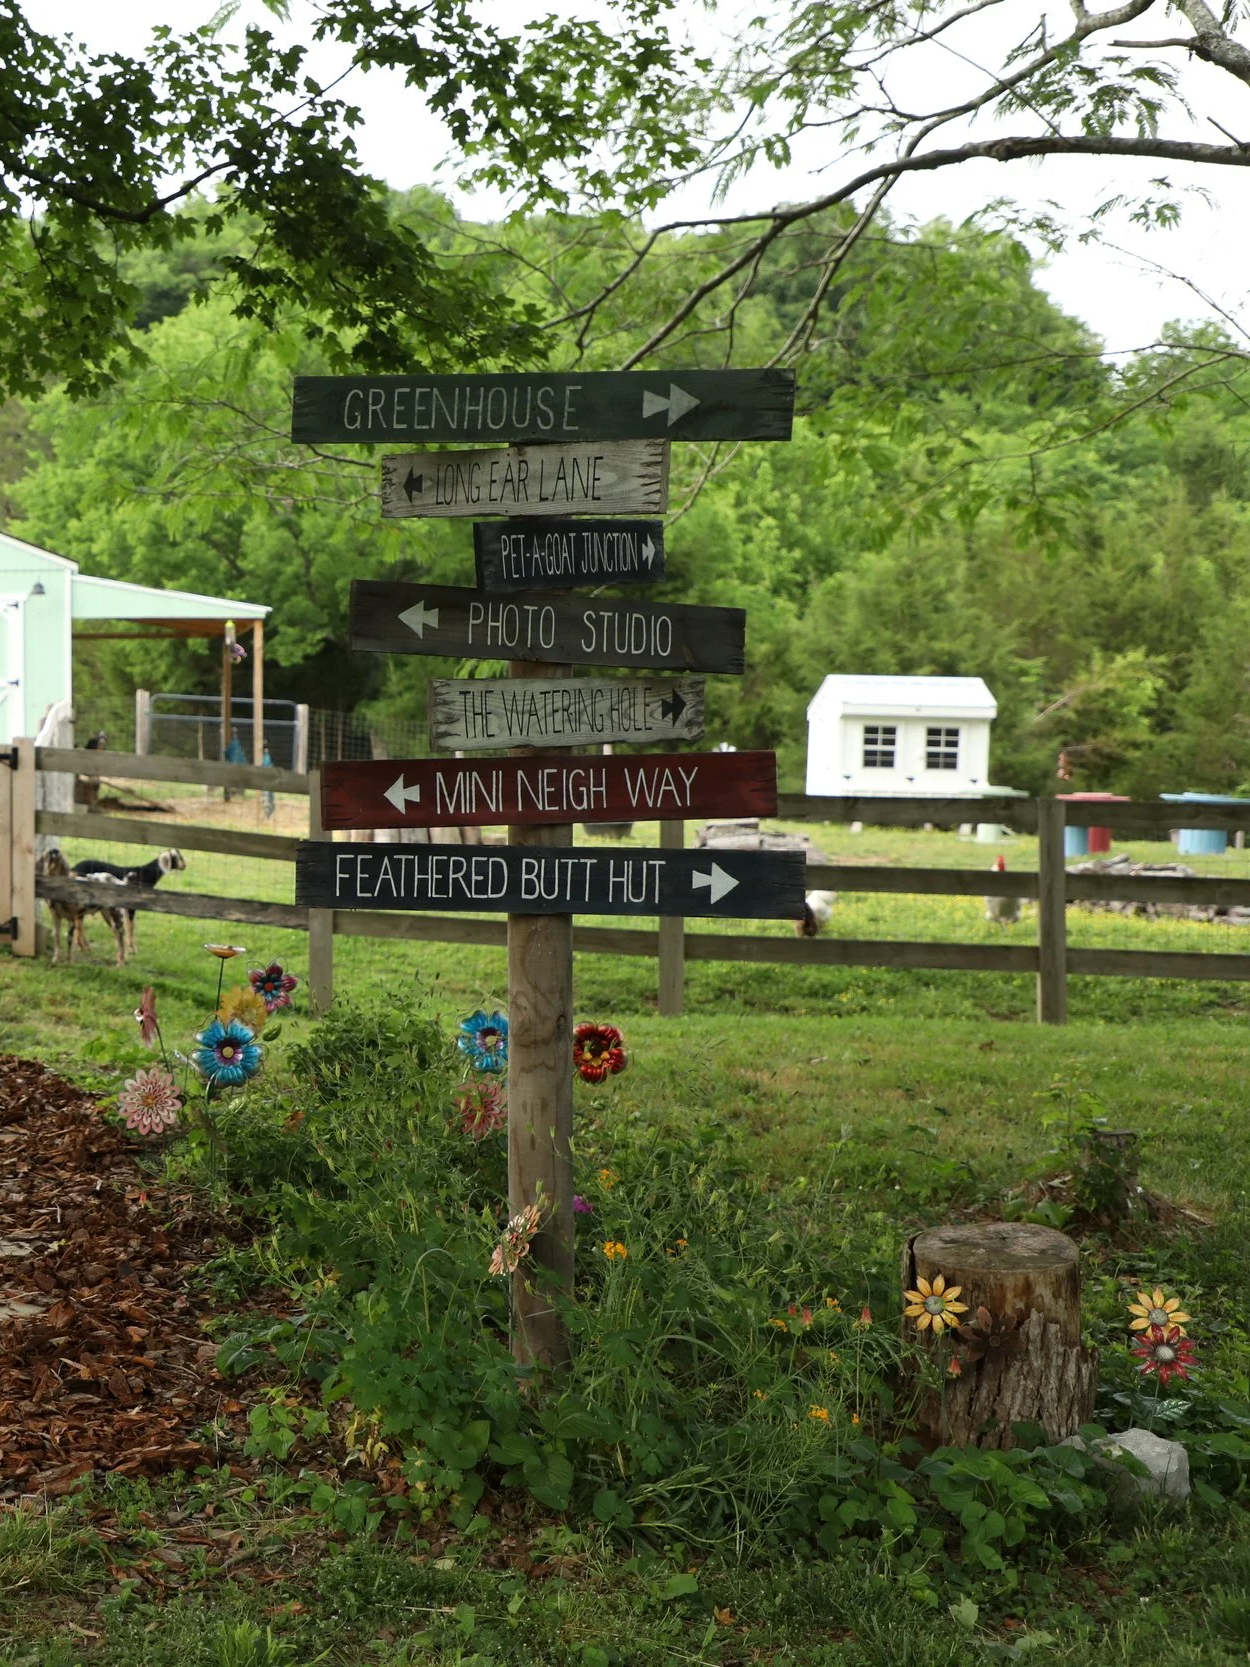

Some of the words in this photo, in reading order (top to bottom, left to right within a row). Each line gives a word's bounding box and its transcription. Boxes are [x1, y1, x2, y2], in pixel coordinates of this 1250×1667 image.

[343, 386, 582, 431] GREENHOUSE
[435, 461, 481, 506] LONG
[489, 459, 531, 503] EAR
[539, 456, 604, 502] LANE
[501, 534, 575, 580] PET-A-GOAT
[581, 532, 639, 575] JUNCTION
[468, 602, 555, 649] PHOTO
[581, 610, 672, 657] STUDIO
[459, 690, 495, 739] THE
[502, 688, 604, 737] WATERING
[611, 687, 653, 733] HOLE
[436, 769, 502, 815] MINI
[517, 768, 607, 812] NEIGH
[624, 766, 698, 808] WAY
[335, 854, 508, 898] FEATHERED
[521, 858, 598, 902] BUTT
[610, 860, 666, 904] HUT
